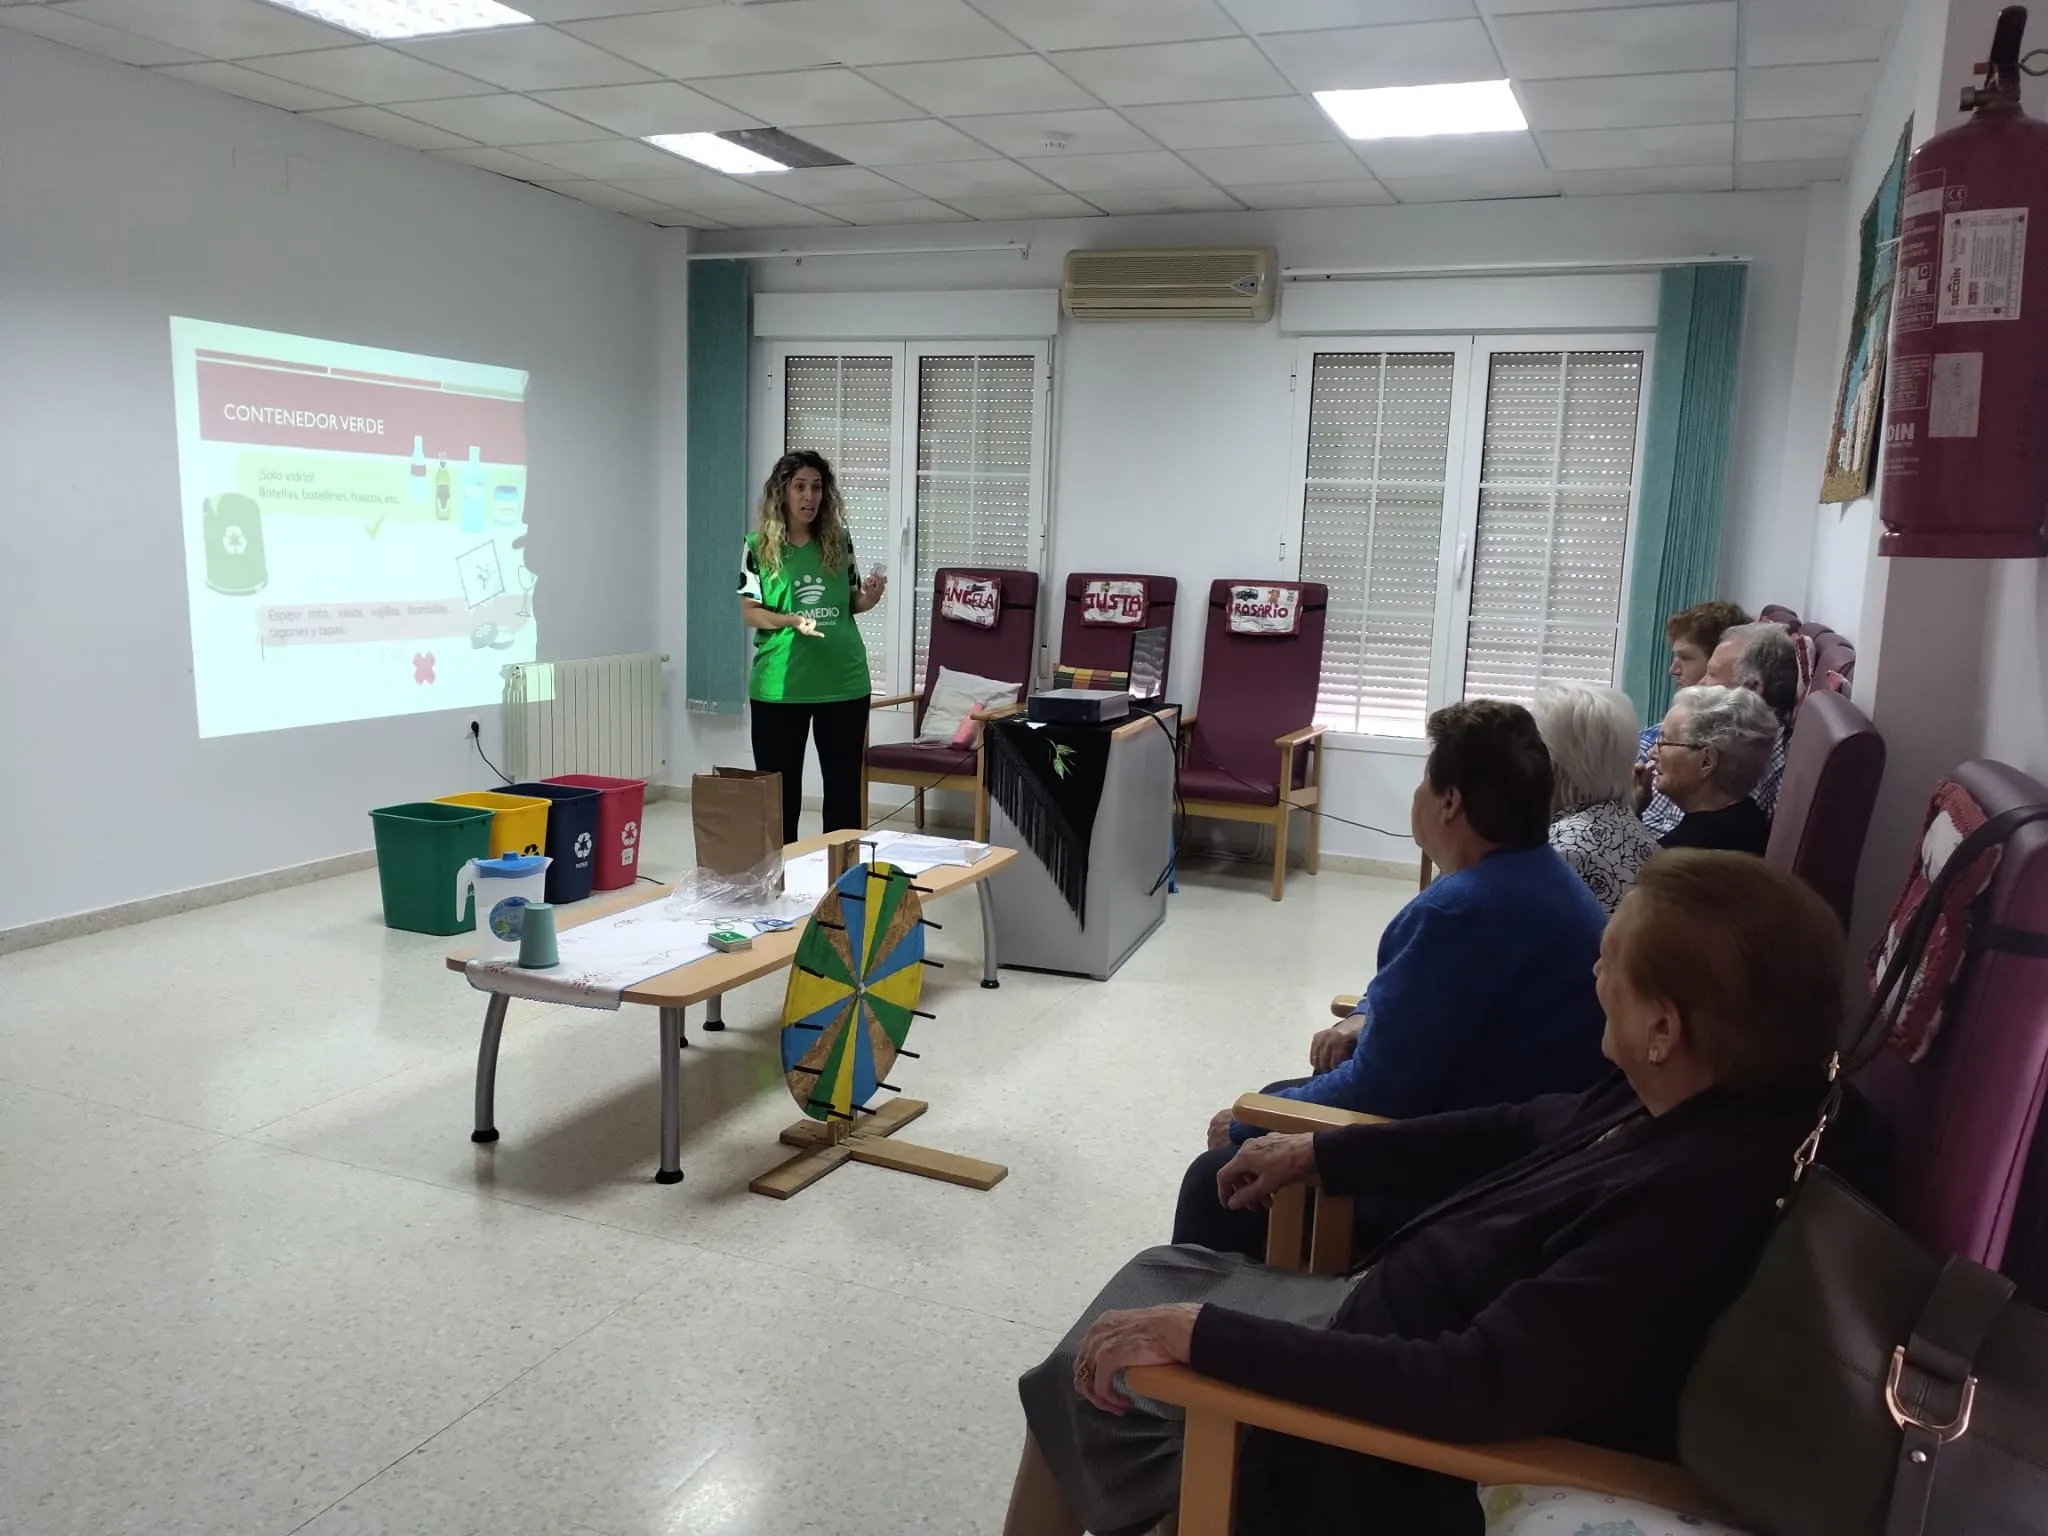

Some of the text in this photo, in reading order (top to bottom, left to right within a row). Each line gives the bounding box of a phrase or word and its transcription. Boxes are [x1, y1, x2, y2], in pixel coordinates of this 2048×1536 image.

[223, 403, 385, 434] CONTENEDOR VERDE
[943, 587, 995, 609] ANGELA
[1084, 593, 1141, 616] JUSTA
